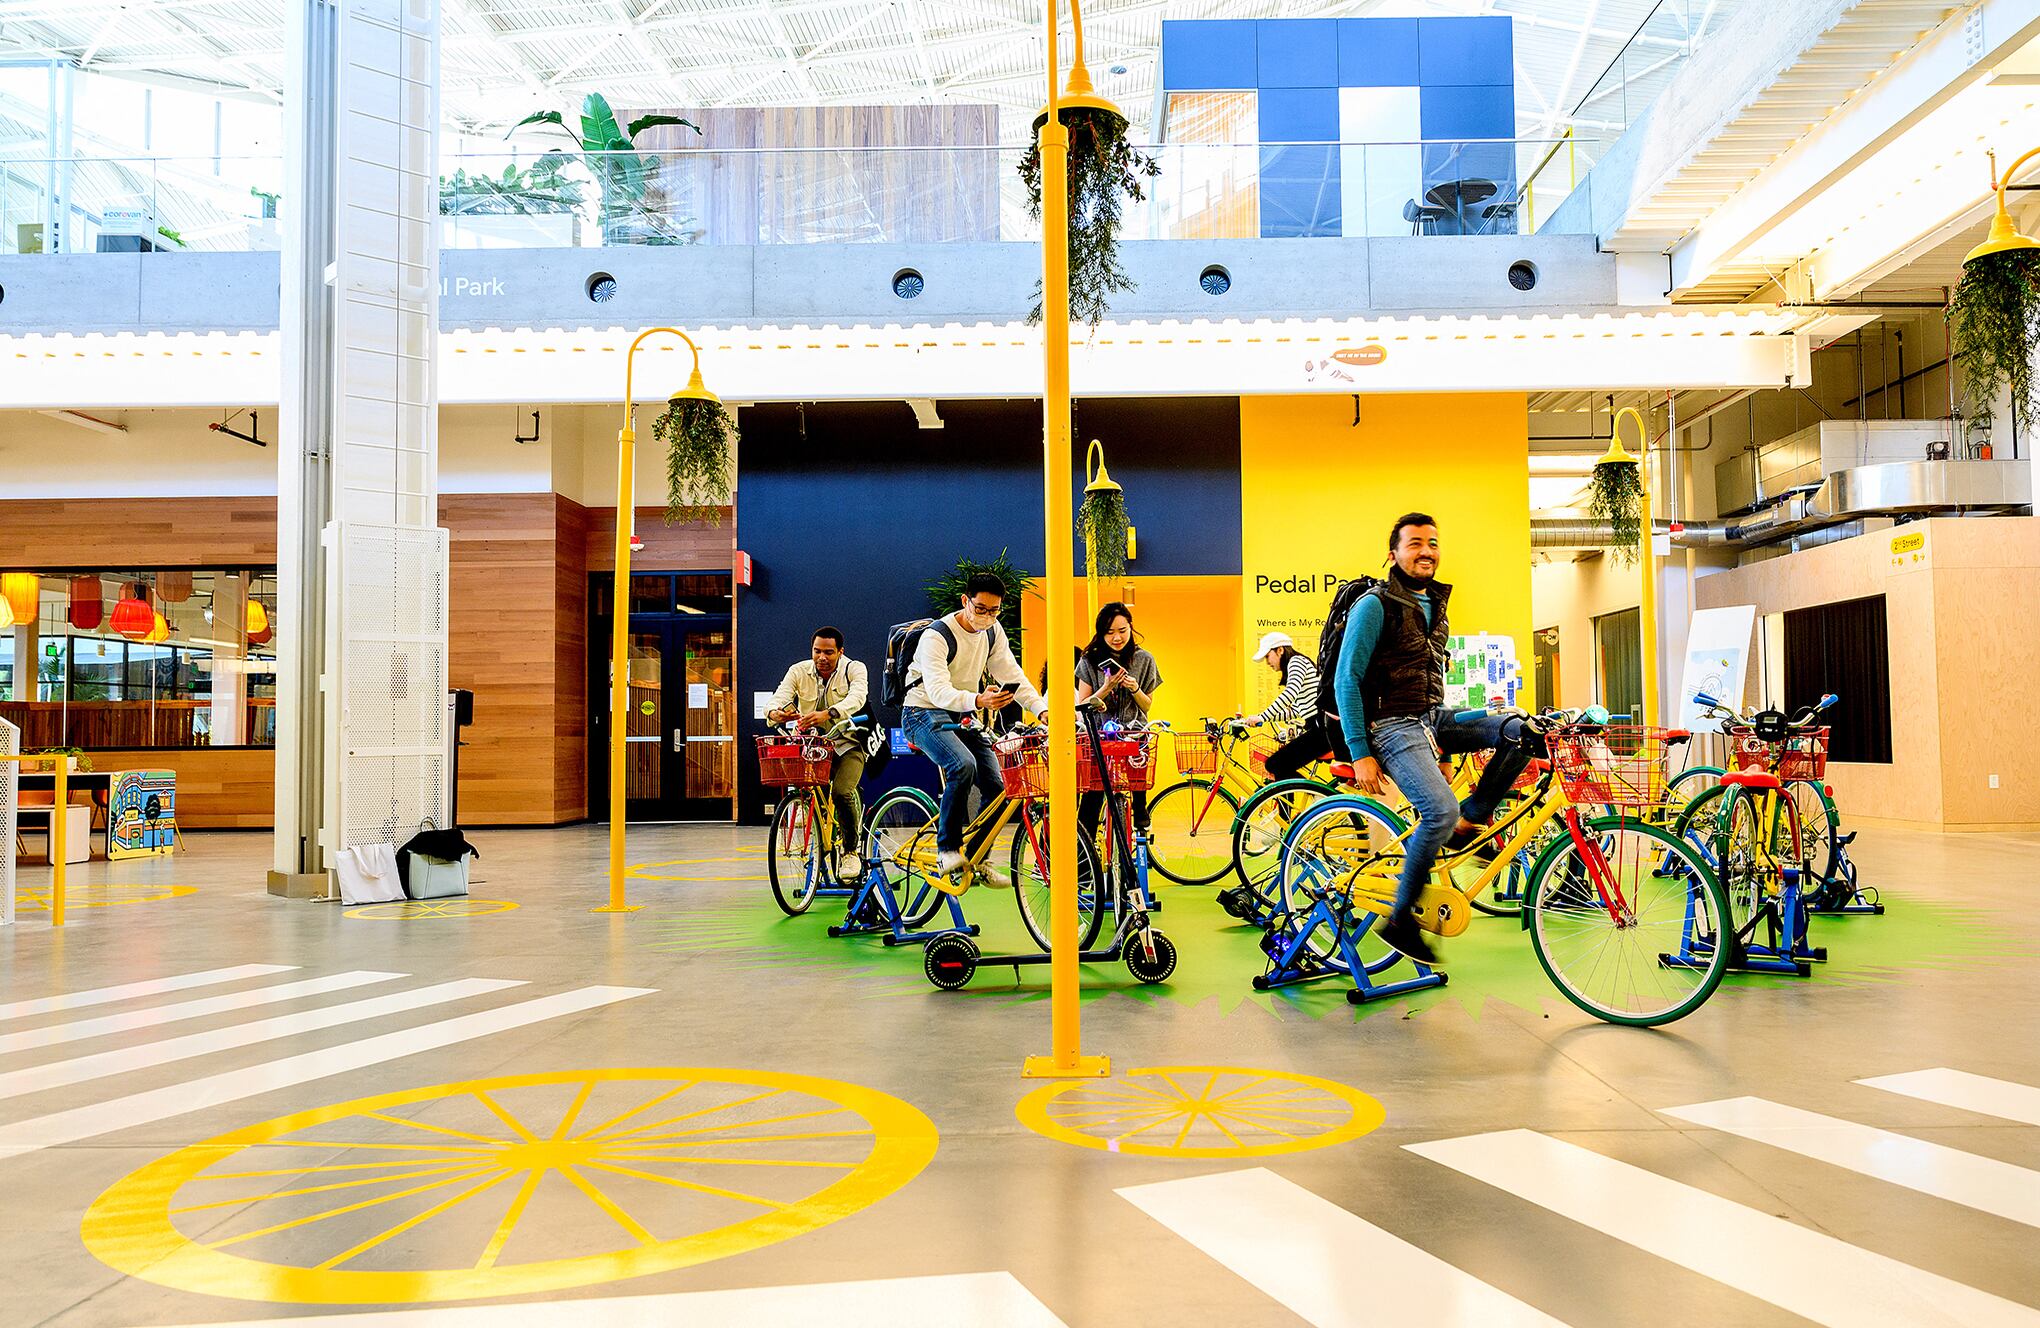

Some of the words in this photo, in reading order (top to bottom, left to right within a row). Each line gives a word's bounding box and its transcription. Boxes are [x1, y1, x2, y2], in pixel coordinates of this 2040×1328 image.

[455, 276, 505, 296] Park
[1256, 574, 1316, 593] Pedal
[1324, 574, 1363, 592] Pa
[1257, 619, 1287, 627] Where
[1289, 619, 1296, 627] is
[1299, 619, 1312, 629] My
